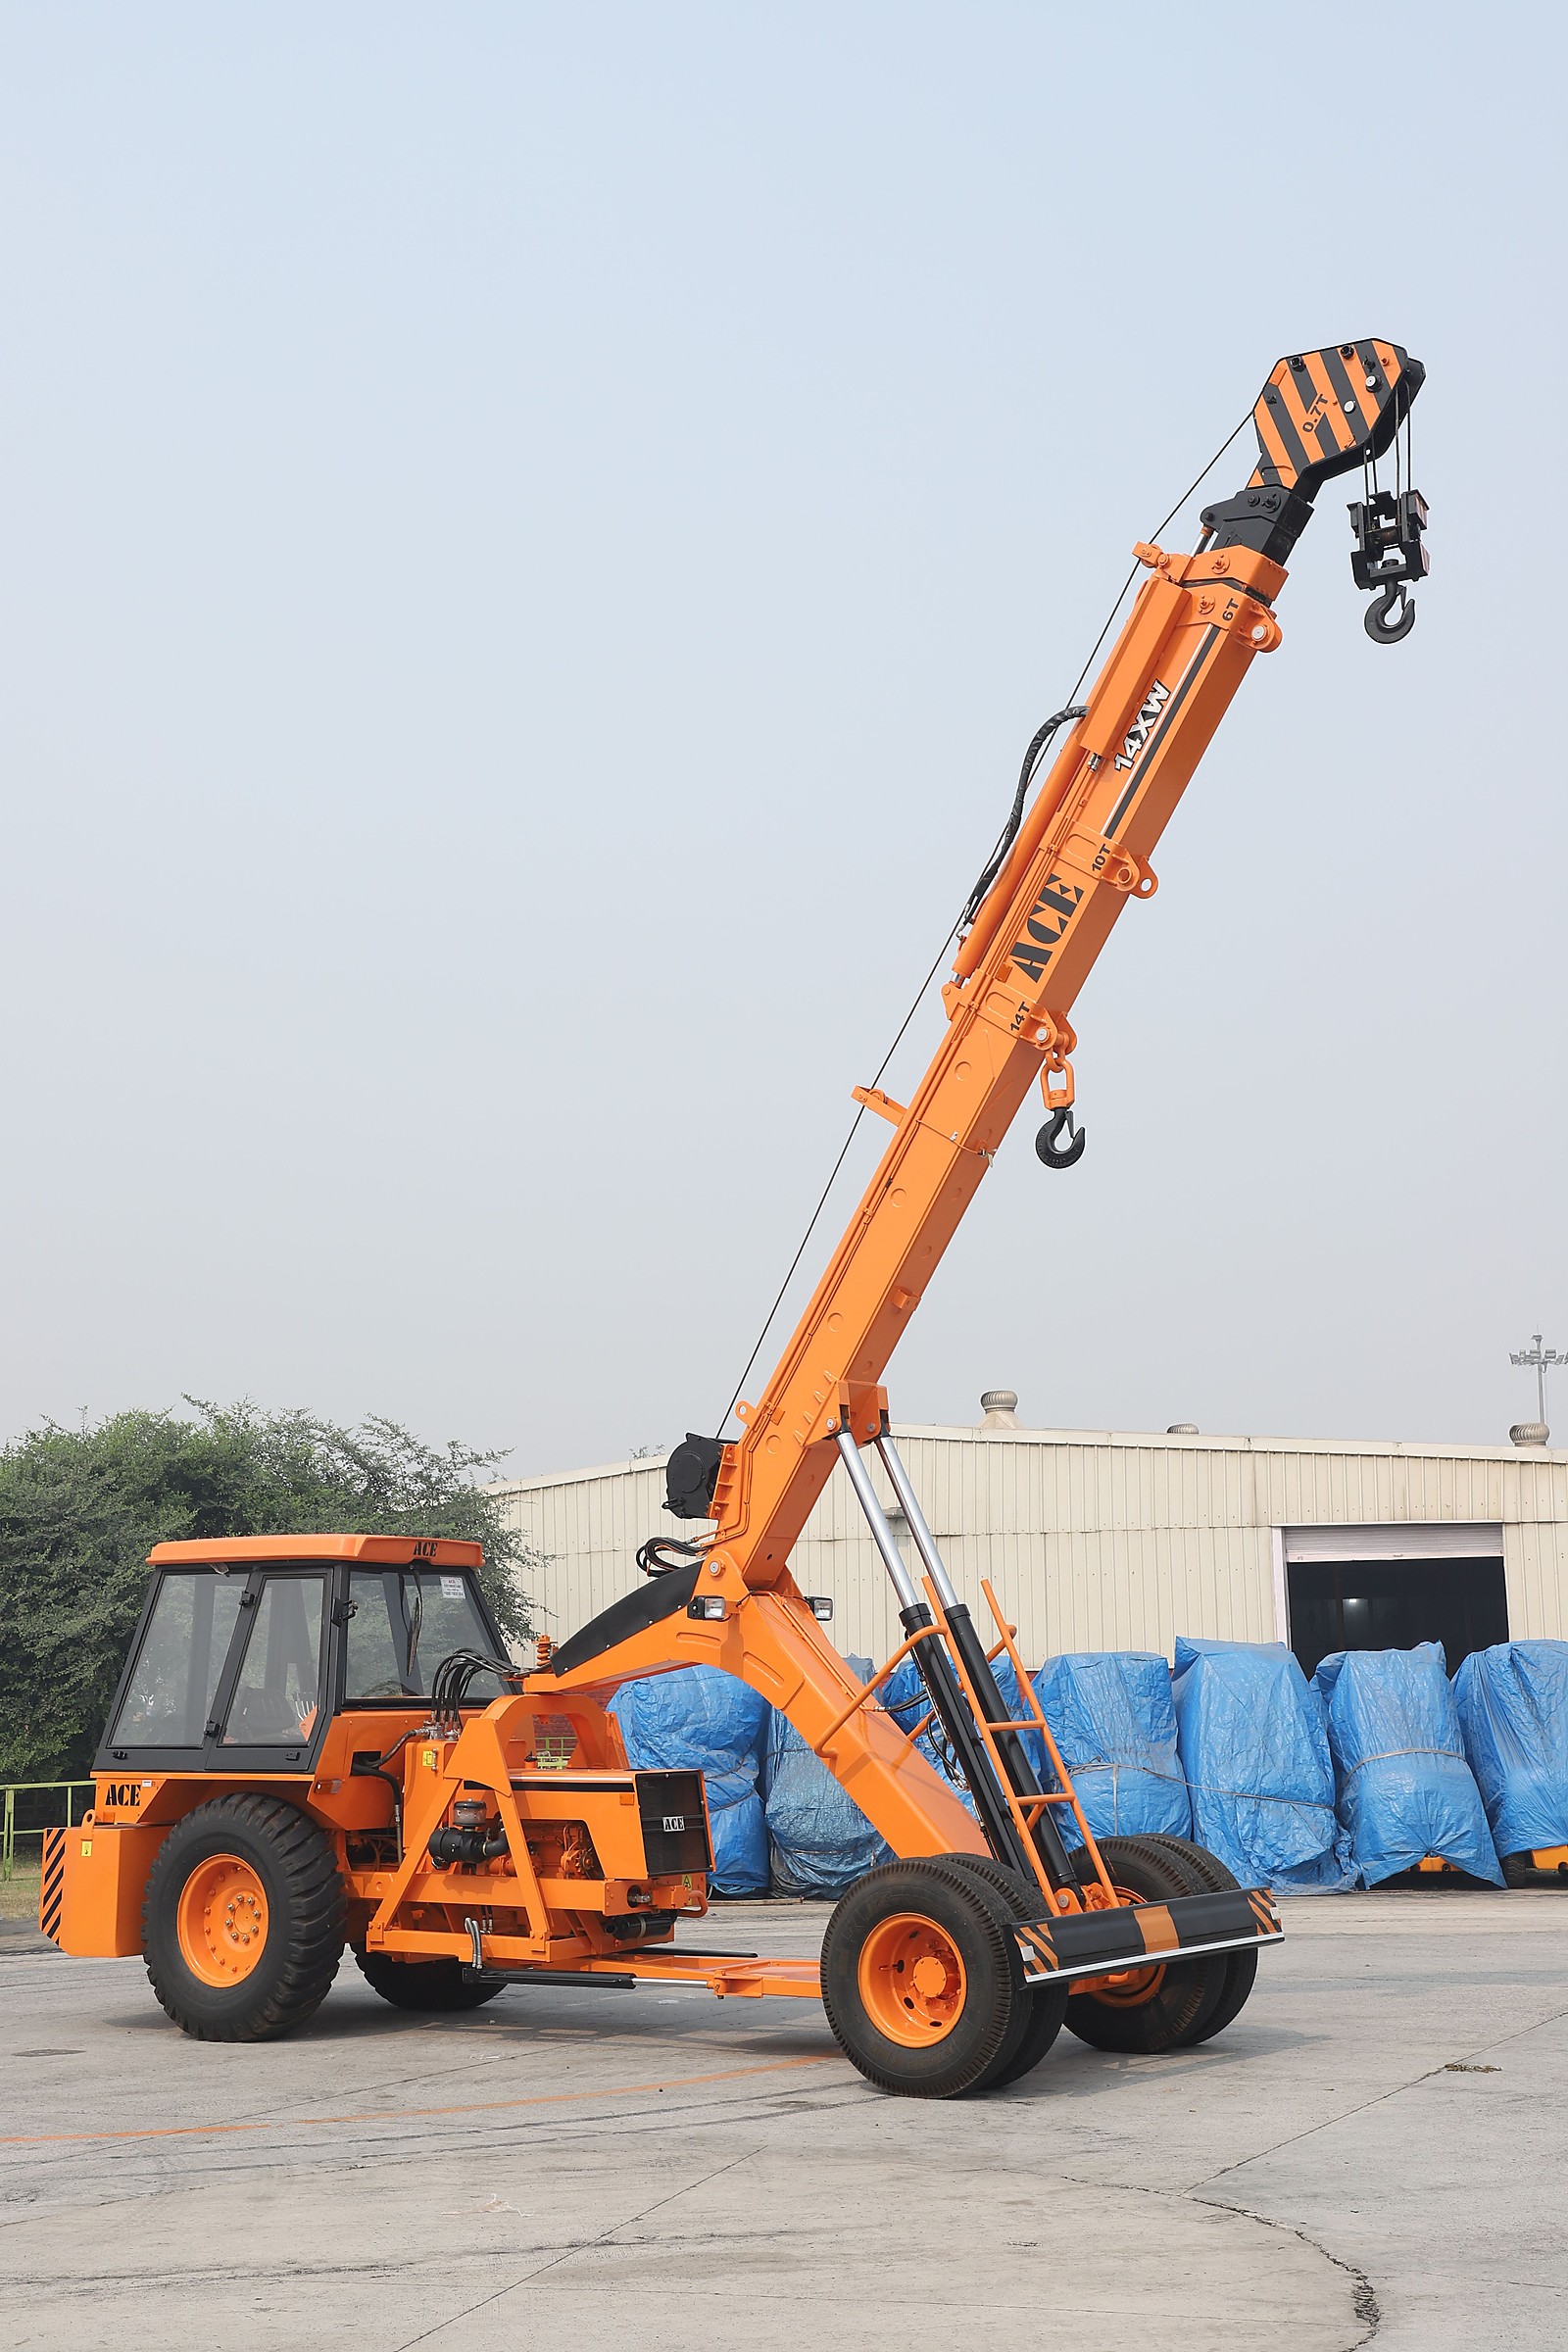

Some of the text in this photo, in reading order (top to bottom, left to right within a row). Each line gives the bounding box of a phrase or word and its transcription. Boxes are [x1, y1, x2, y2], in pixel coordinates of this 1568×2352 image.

[1302, 393, 1328, 432] 0.7T
[1222, 598, 1239, 621] 6T
[1114, 678, 1171, 771] 14XW
[1092, 843, 1110, 871] 10T
[1009, 872, 1085, 983] ACE
[1010, 1001, 1030, 1031] 14T
[413, 1541, 438, 1556] ACE
[105, 1784, 141, 1806] ACE
[664, 1817, 684, 1831] ACE
